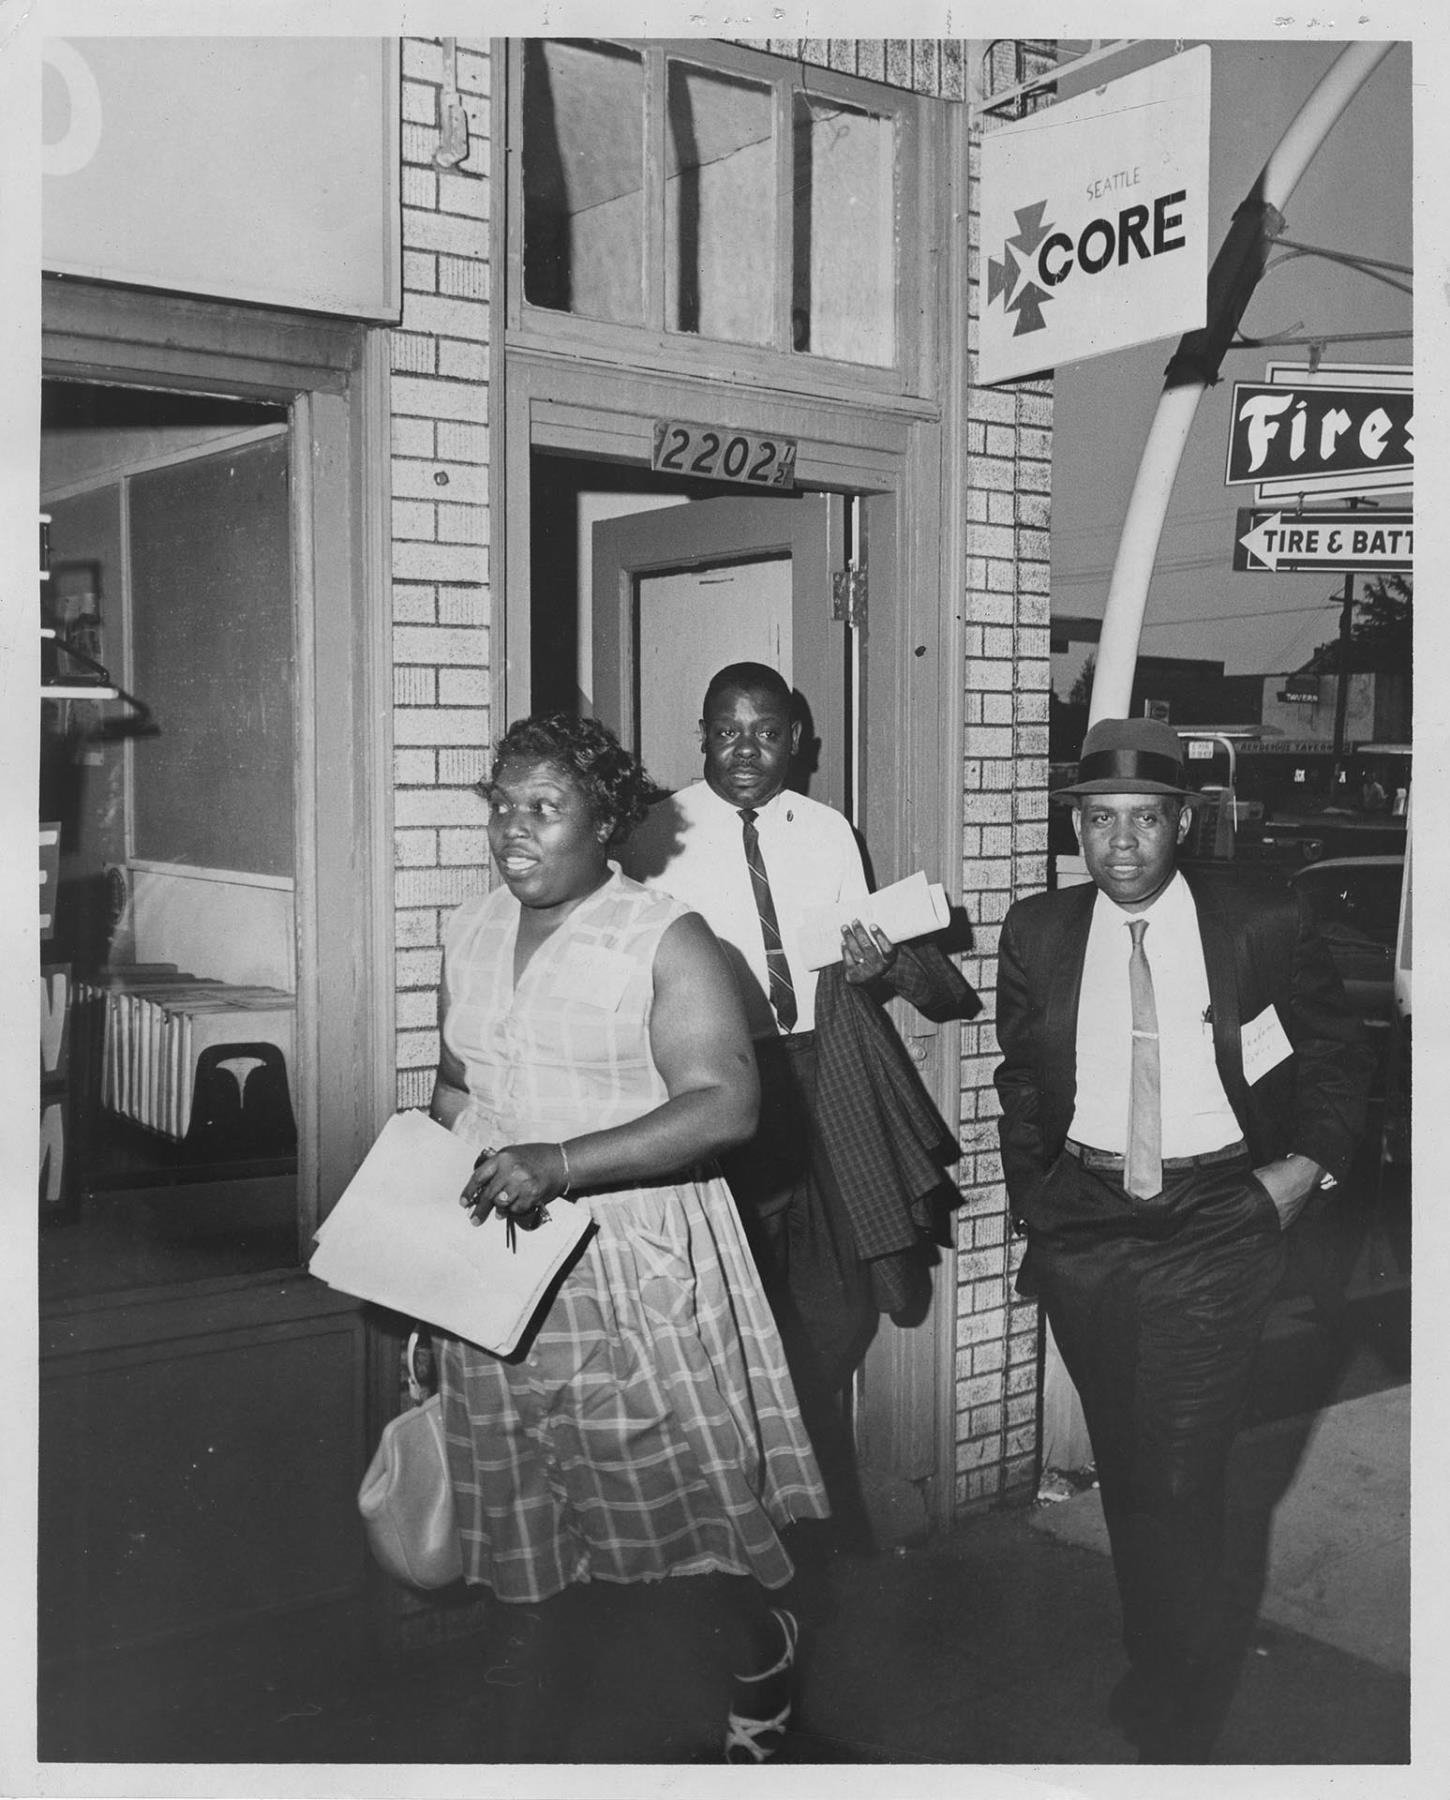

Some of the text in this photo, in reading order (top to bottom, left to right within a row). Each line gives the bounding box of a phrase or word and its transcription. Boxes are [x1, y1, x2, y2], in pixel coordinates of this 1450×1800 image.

[1086, 166, 1141, 201] SEATTLE
[1038, 189, 1186, 287] CORE
[1263, 530, 1319, 553] TIRE
[1327, 530, 1343, 554] &
[1286, 693, 1319, 702] TAVERN
